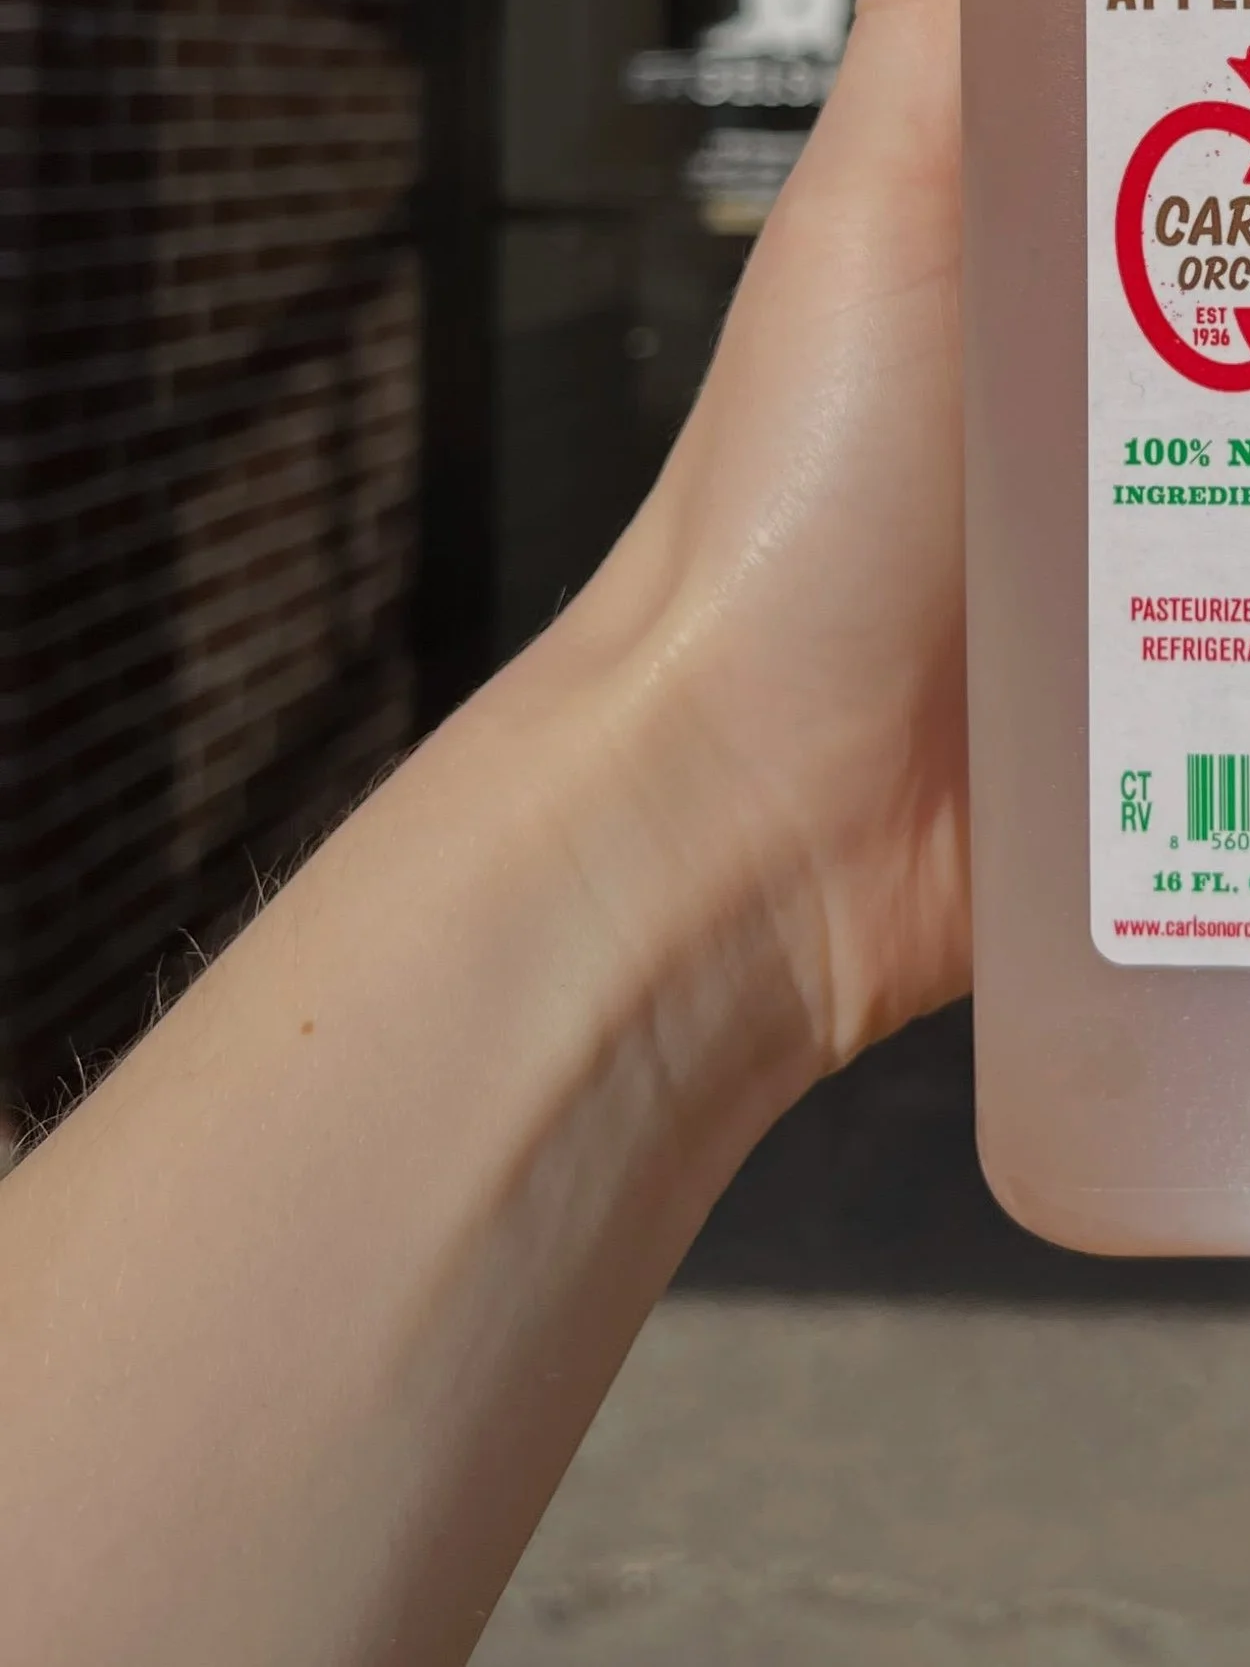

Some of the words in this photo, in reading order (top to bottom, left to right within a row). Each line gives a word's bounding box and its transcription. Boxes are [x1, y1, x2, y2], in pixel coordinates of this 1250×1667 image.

[1195, 306, 1228, 325] EST
[1192, 328, 1231, 347] 1936
[1124, 437, 1212, 467] 100%
[1120, 769, 1152, 801] CT
[1121, 801, 1152, 832] RV
[1169, 835, 1180, 850] 8
[1153, 871, 1183, 893] 16
[1191, 872, 1239, 894] FL.
